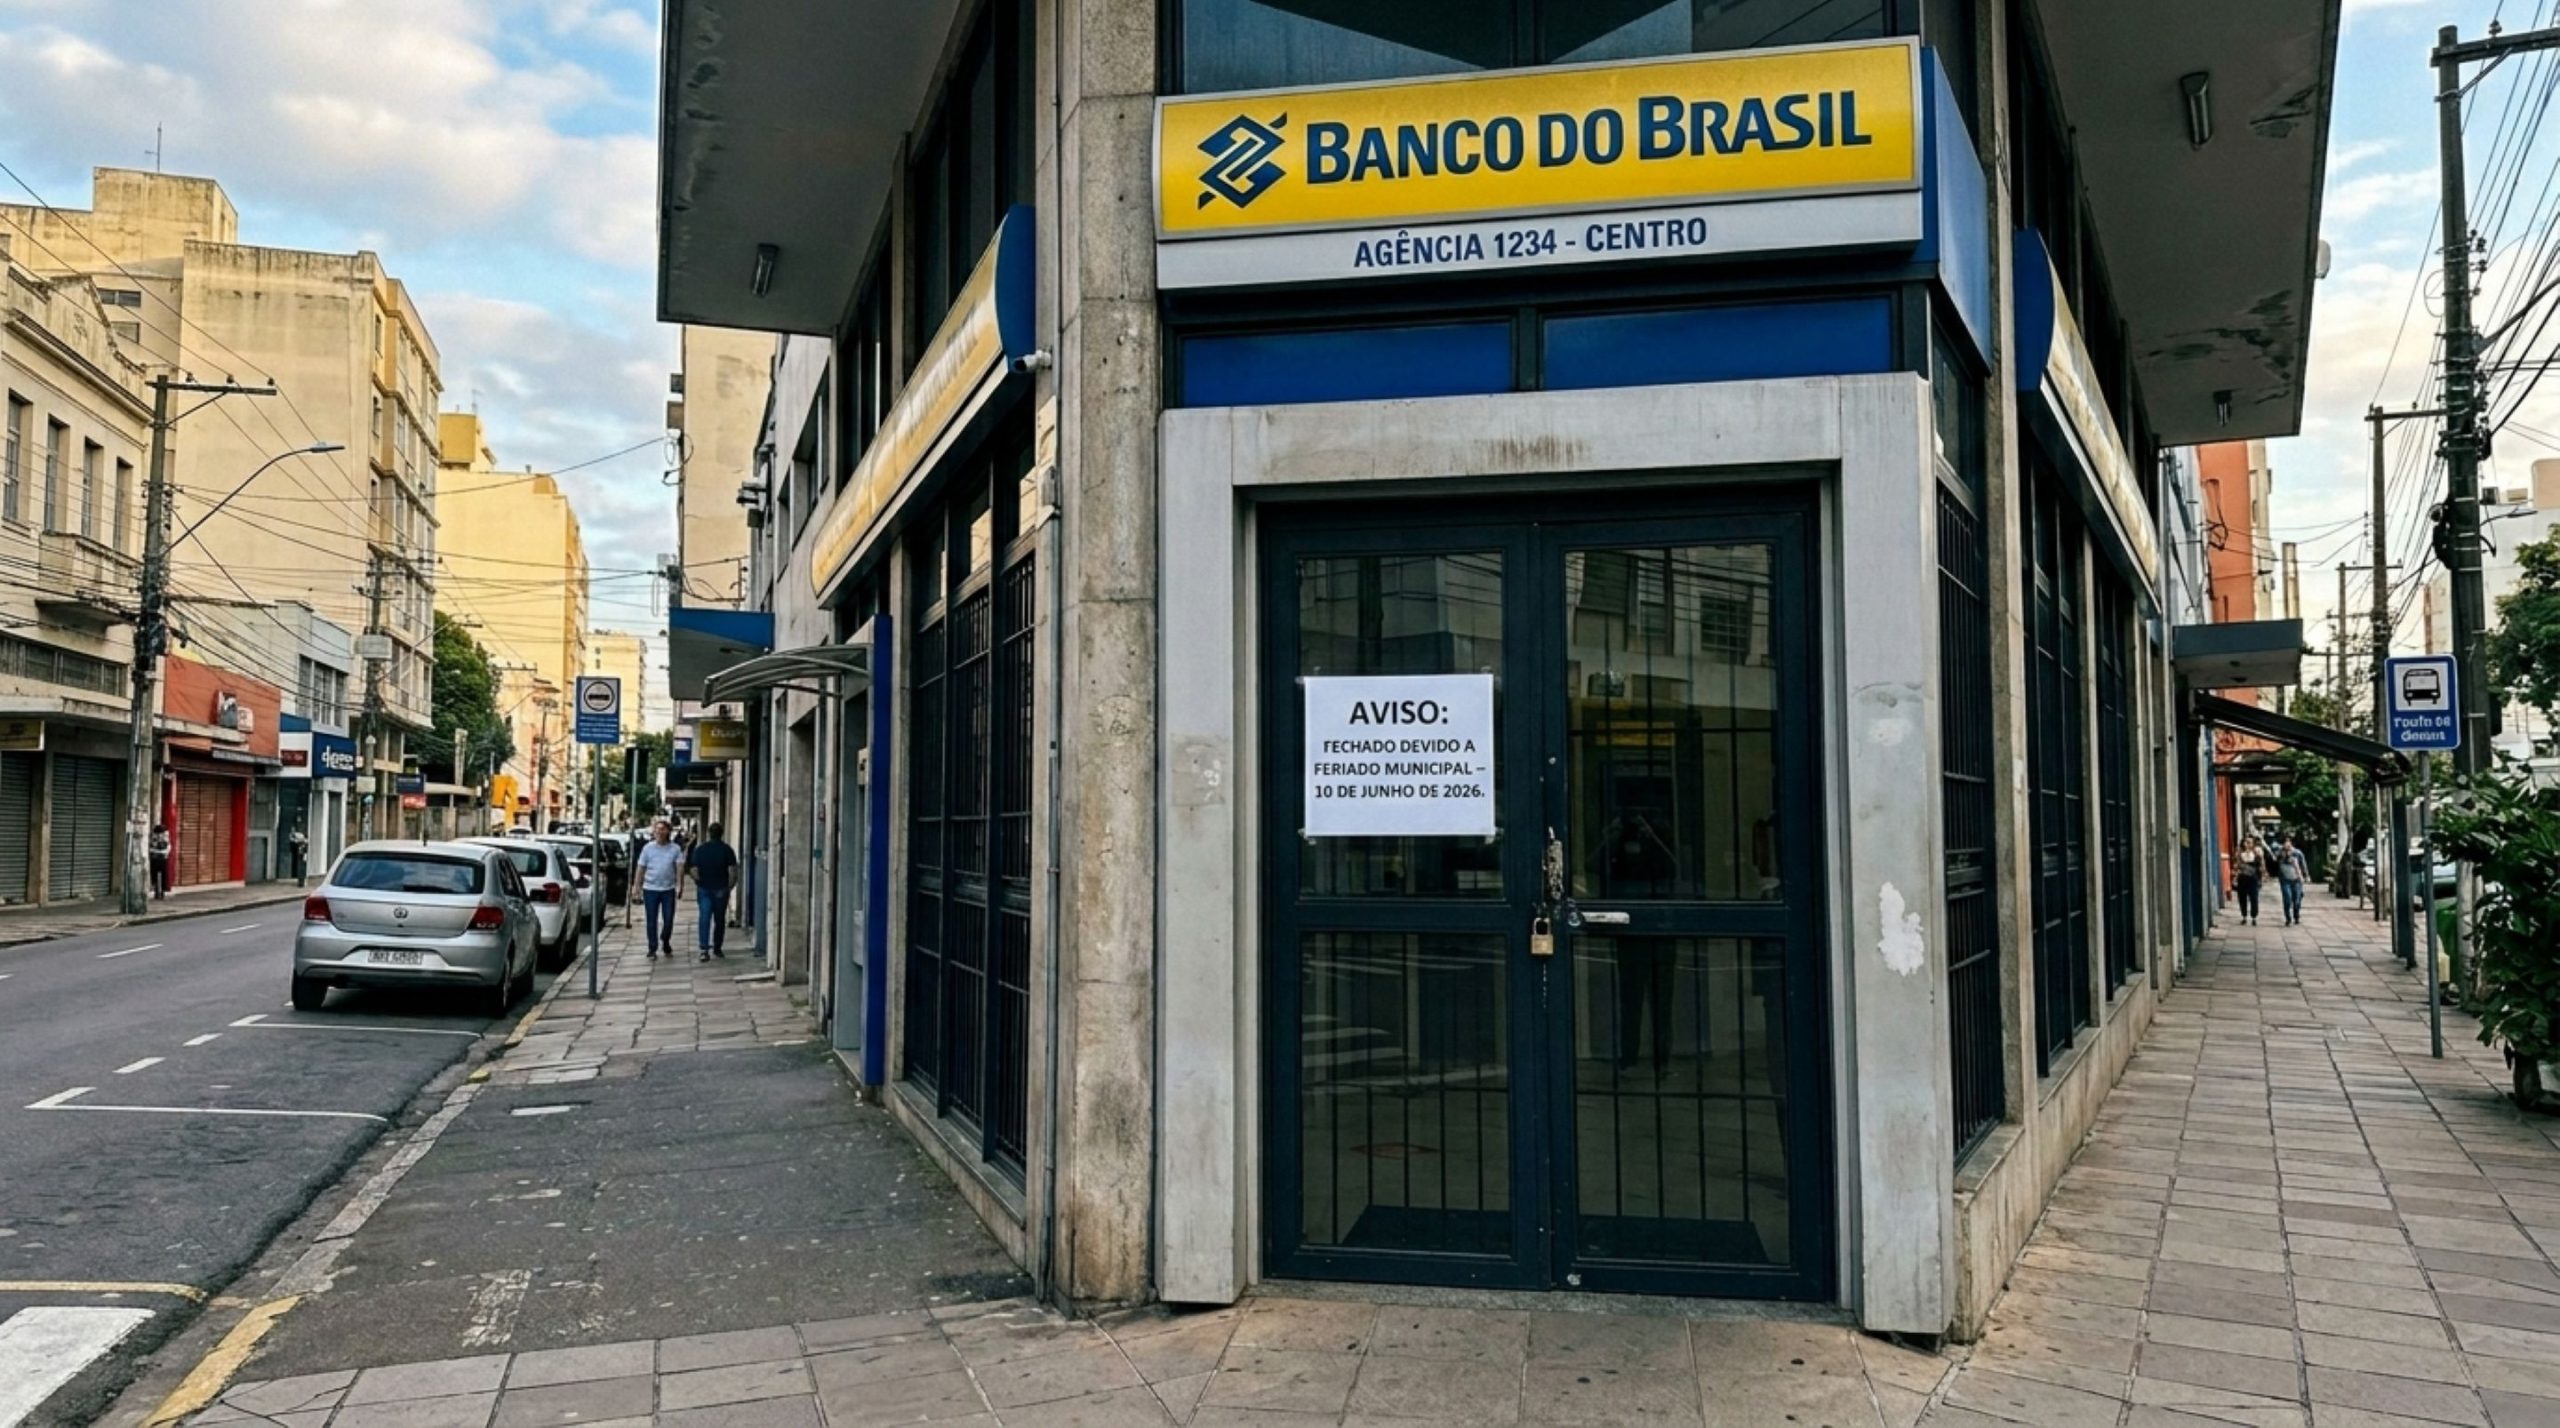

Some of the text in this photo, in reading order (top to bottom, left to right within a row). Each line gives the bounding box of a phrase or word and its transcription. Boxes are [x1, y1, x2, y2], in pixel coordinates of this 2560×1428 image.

[1306, 90, 1872, 185] BANCO DO BRASIL
[1354, 230, 1485, 267] AGÊNCIA
[1494, 229, 1557, 259] 1234
[1585, 218, 1707, 252] CENTRO
[1349, 700, 1448, 725] AVISO:
[1323, 739, 1476, 753] FECHADO DEVIDO A
[1314, 763, 1380, 776] FERIADO
[1384, 762, 1473, 776] MUNICIPAL
[1315, 784, 1485, 798] 10 DE JUNHO DE 2026.
